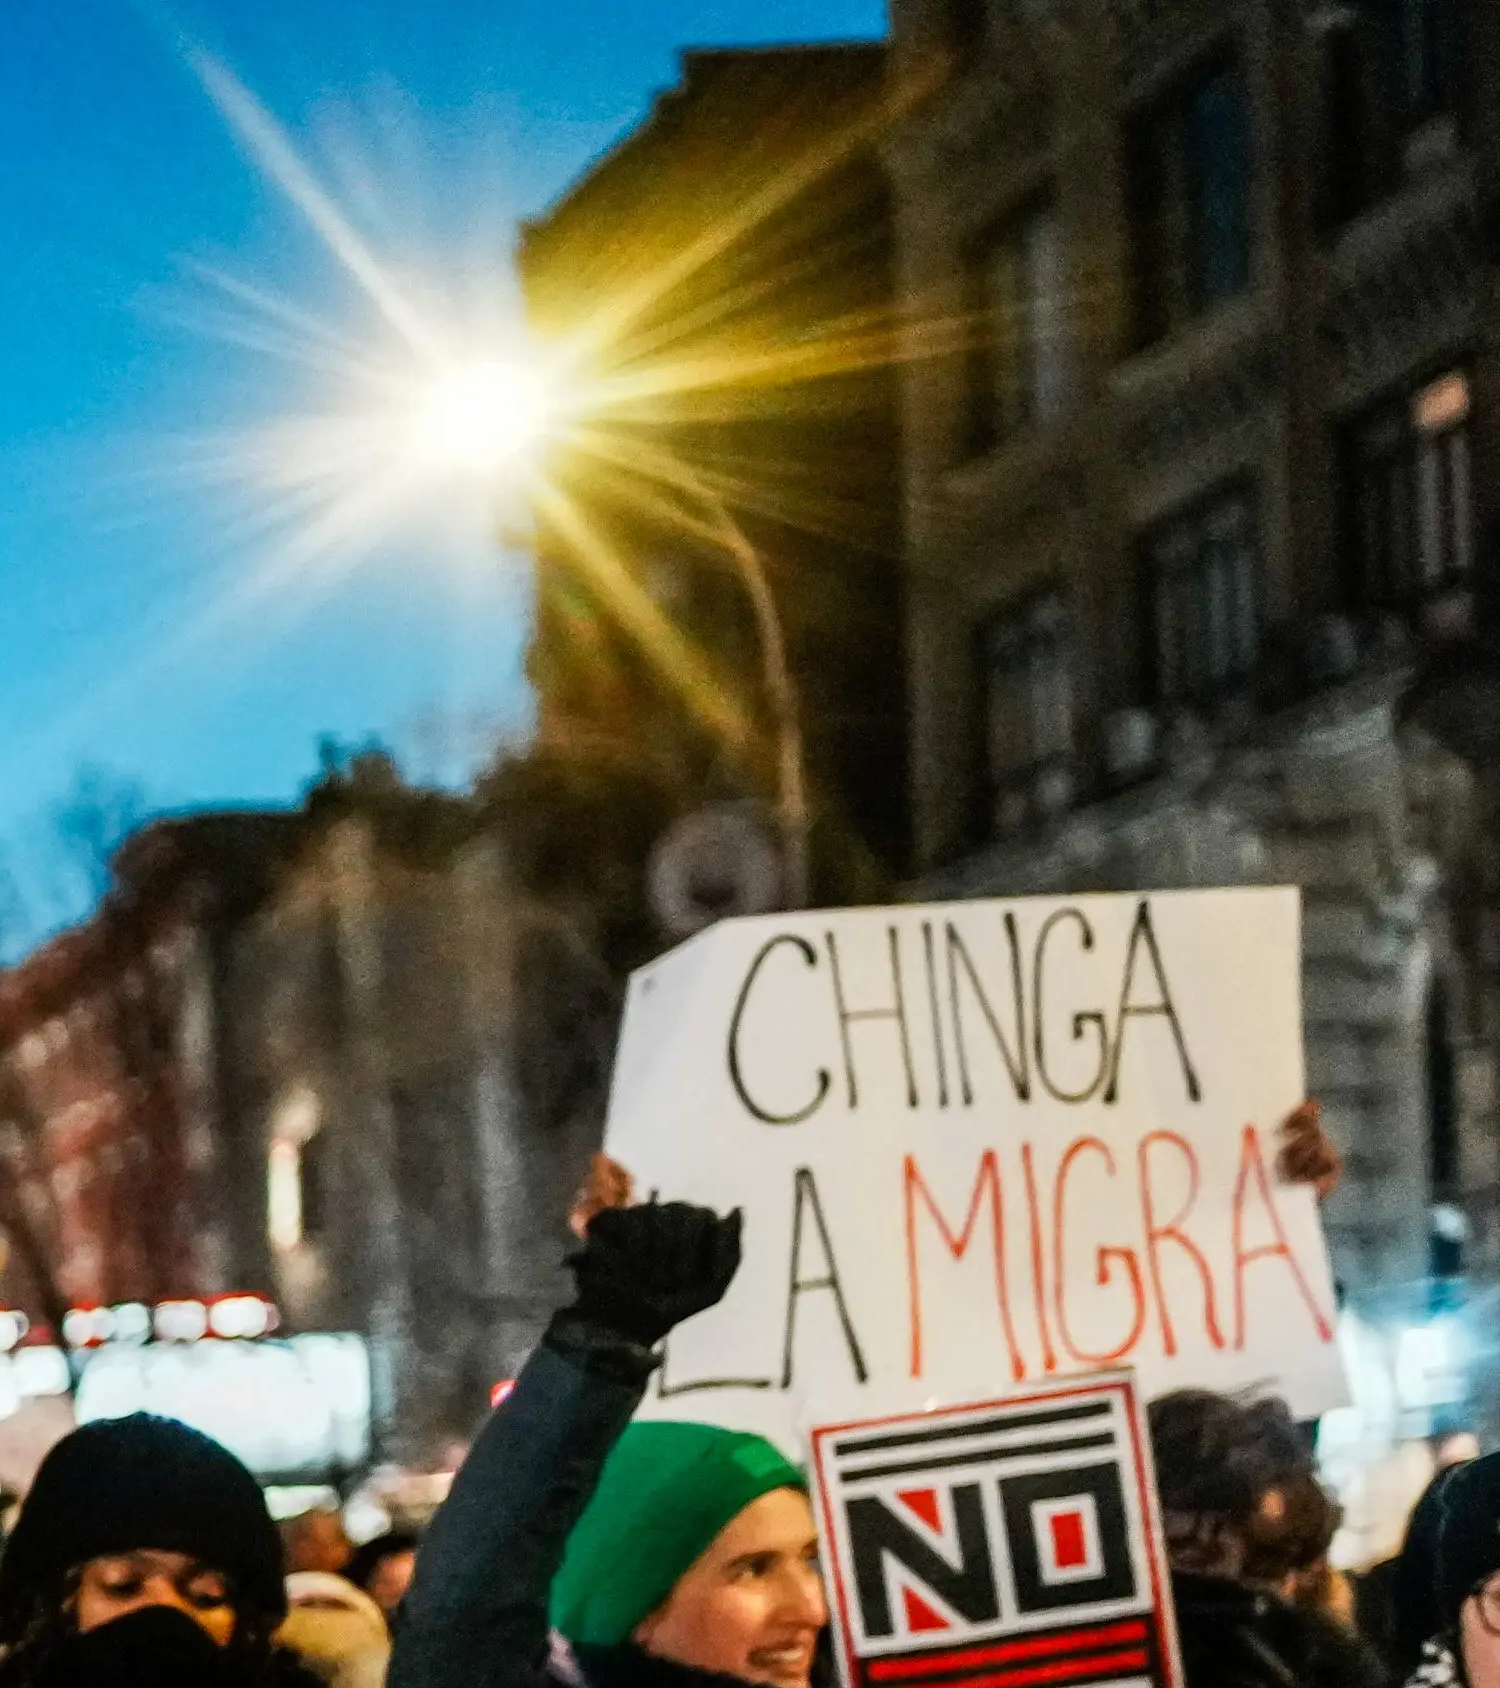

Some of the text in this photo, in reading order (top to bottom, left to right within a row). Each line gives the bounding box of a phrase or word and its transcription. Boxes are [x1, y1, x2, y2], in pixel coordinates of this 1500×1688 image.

[726, 900, 1201, 1126] CHINGA
[902, 1124, 1335, 1382] MIGRA
[845, 1460, 1137, 1638] NO
